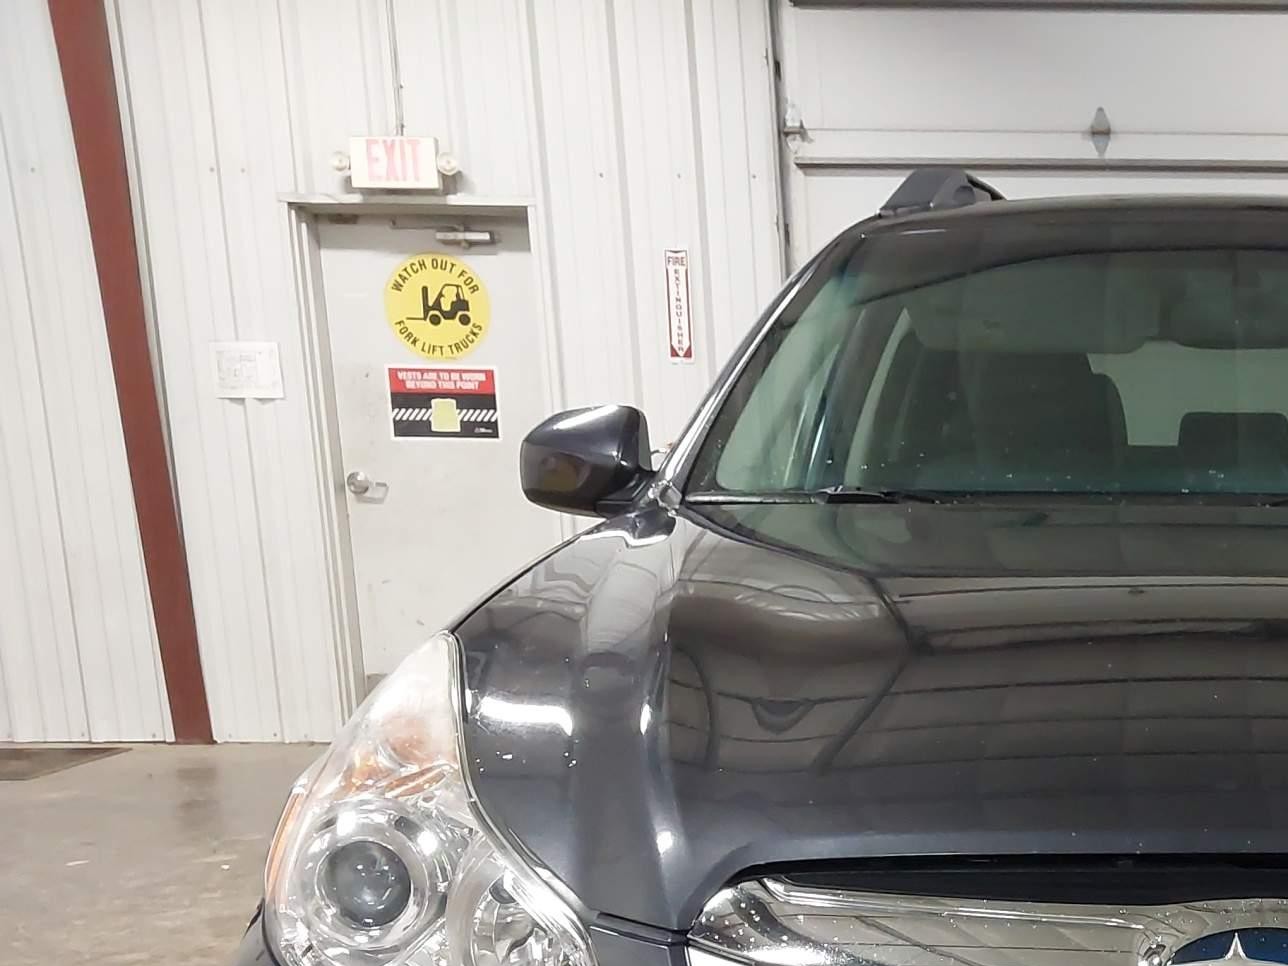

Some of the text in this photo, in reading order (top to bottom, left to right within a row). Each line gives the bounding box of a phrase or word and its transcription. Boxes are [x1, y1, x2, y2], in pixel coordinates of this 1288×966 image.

[366, 139, 421, 181] EXIT
[392, 258, 480, 294] WATCH OUT FOR
[667, 255, 686, 267] FIRE
[674, 268, 685, 352] EXTINGUISHER
[395, 320, 483, 356] FORK LIFT TRUCKS
[439, 373, 449, 381] TO
